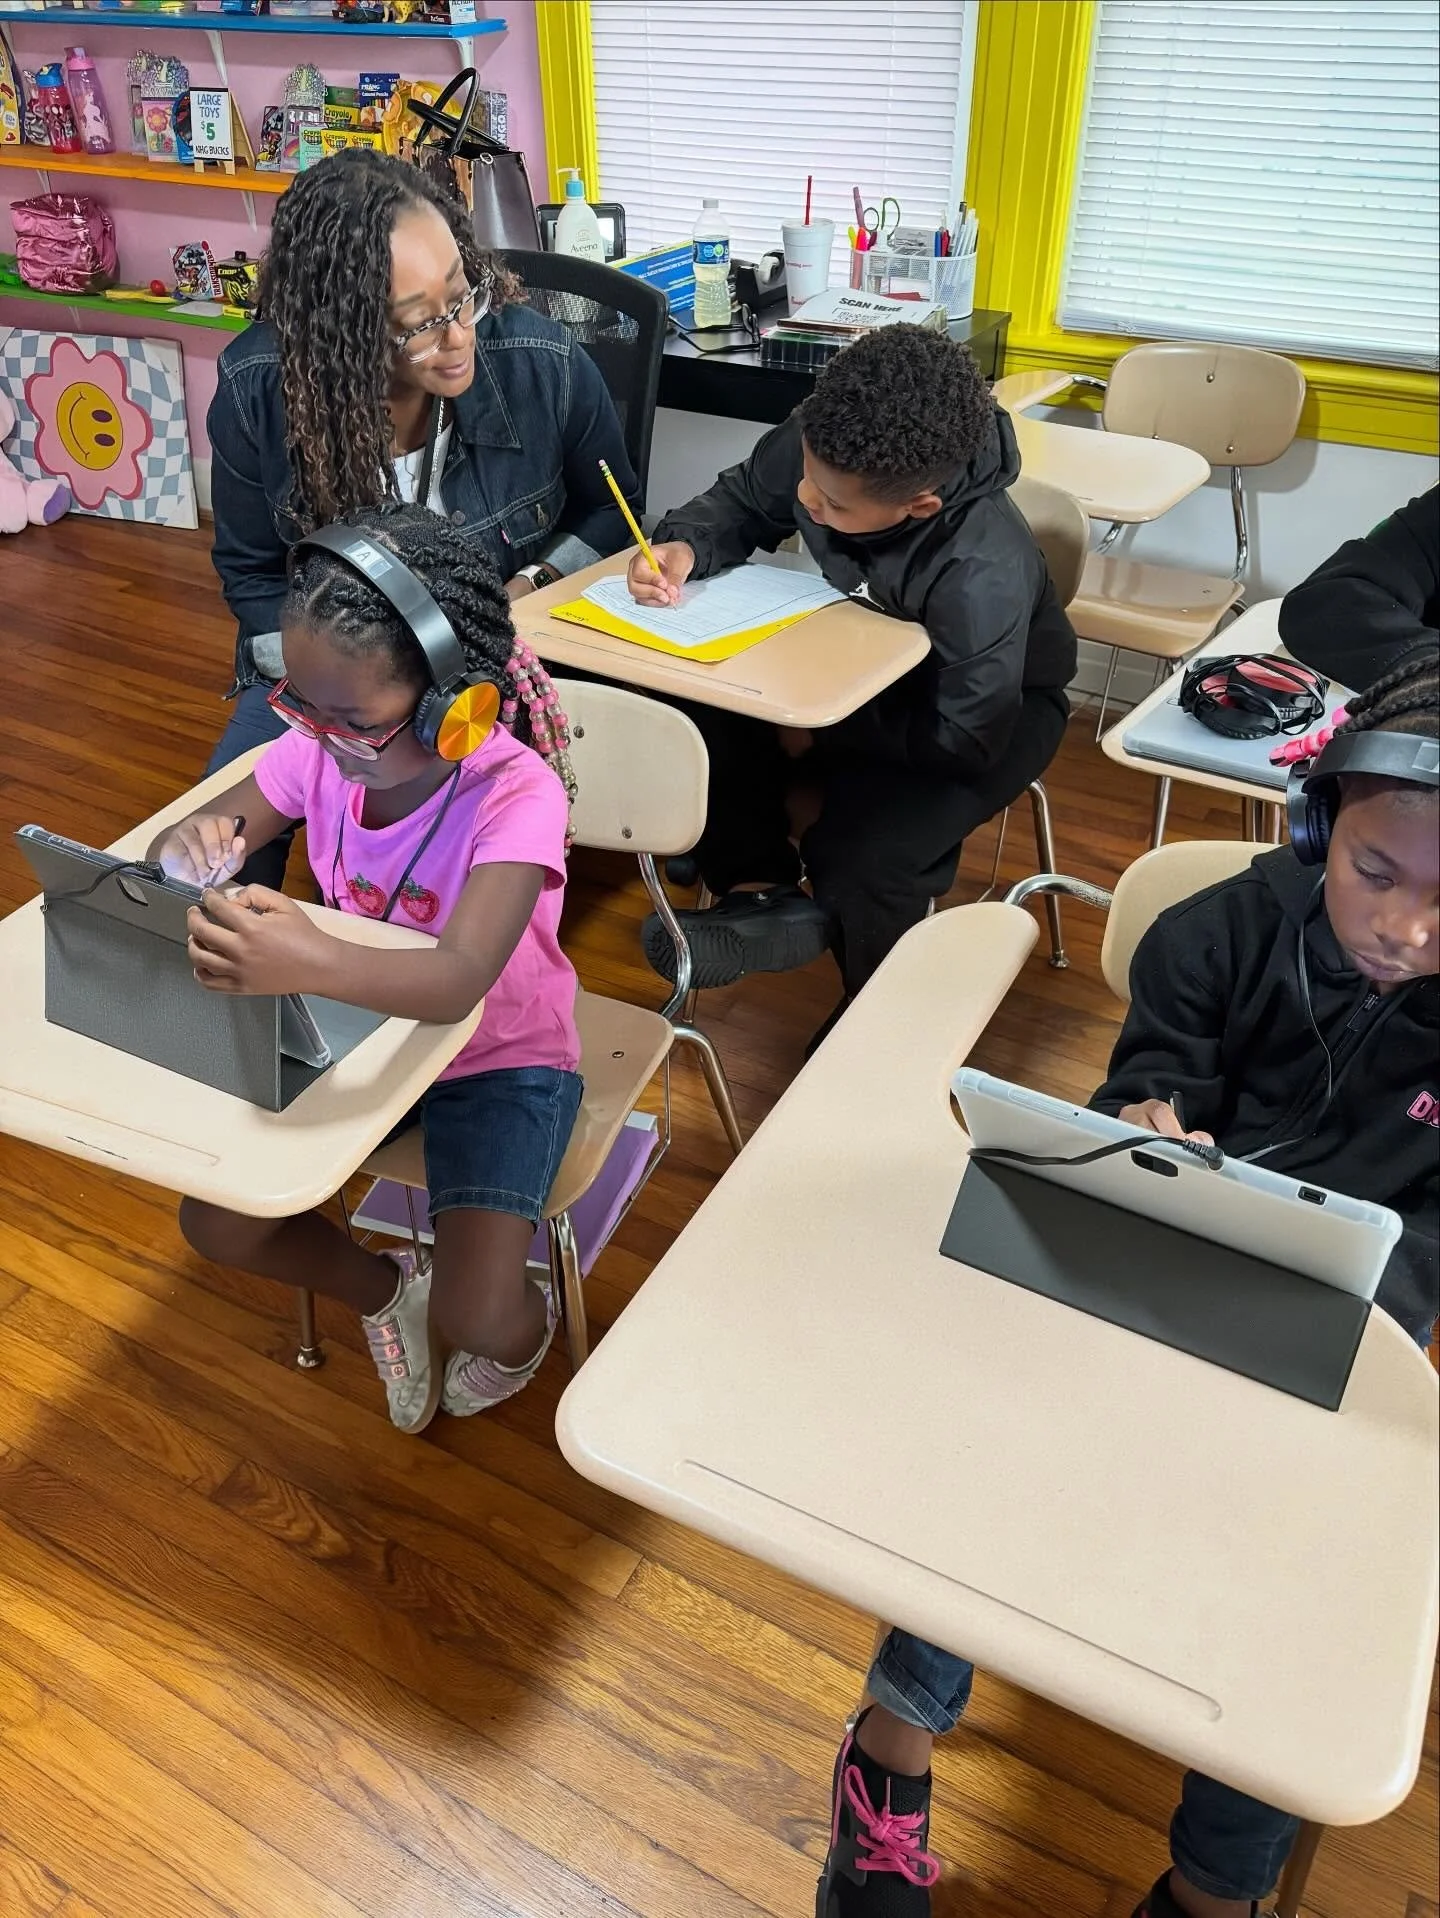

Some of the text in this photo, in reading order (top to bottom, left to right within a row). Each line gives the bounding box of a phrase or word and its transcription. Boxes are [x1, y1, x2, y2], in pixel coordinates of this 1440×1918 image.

[197, 94, 222, 106] LARGE
[200, 107, 220, 118] TOYS
[324, 107, 350, 118] Crayola
[209, 146, 230, 156] BUCKS
[838, 298, 872, 310] SCAN
[356, 552, 371, 561] A
